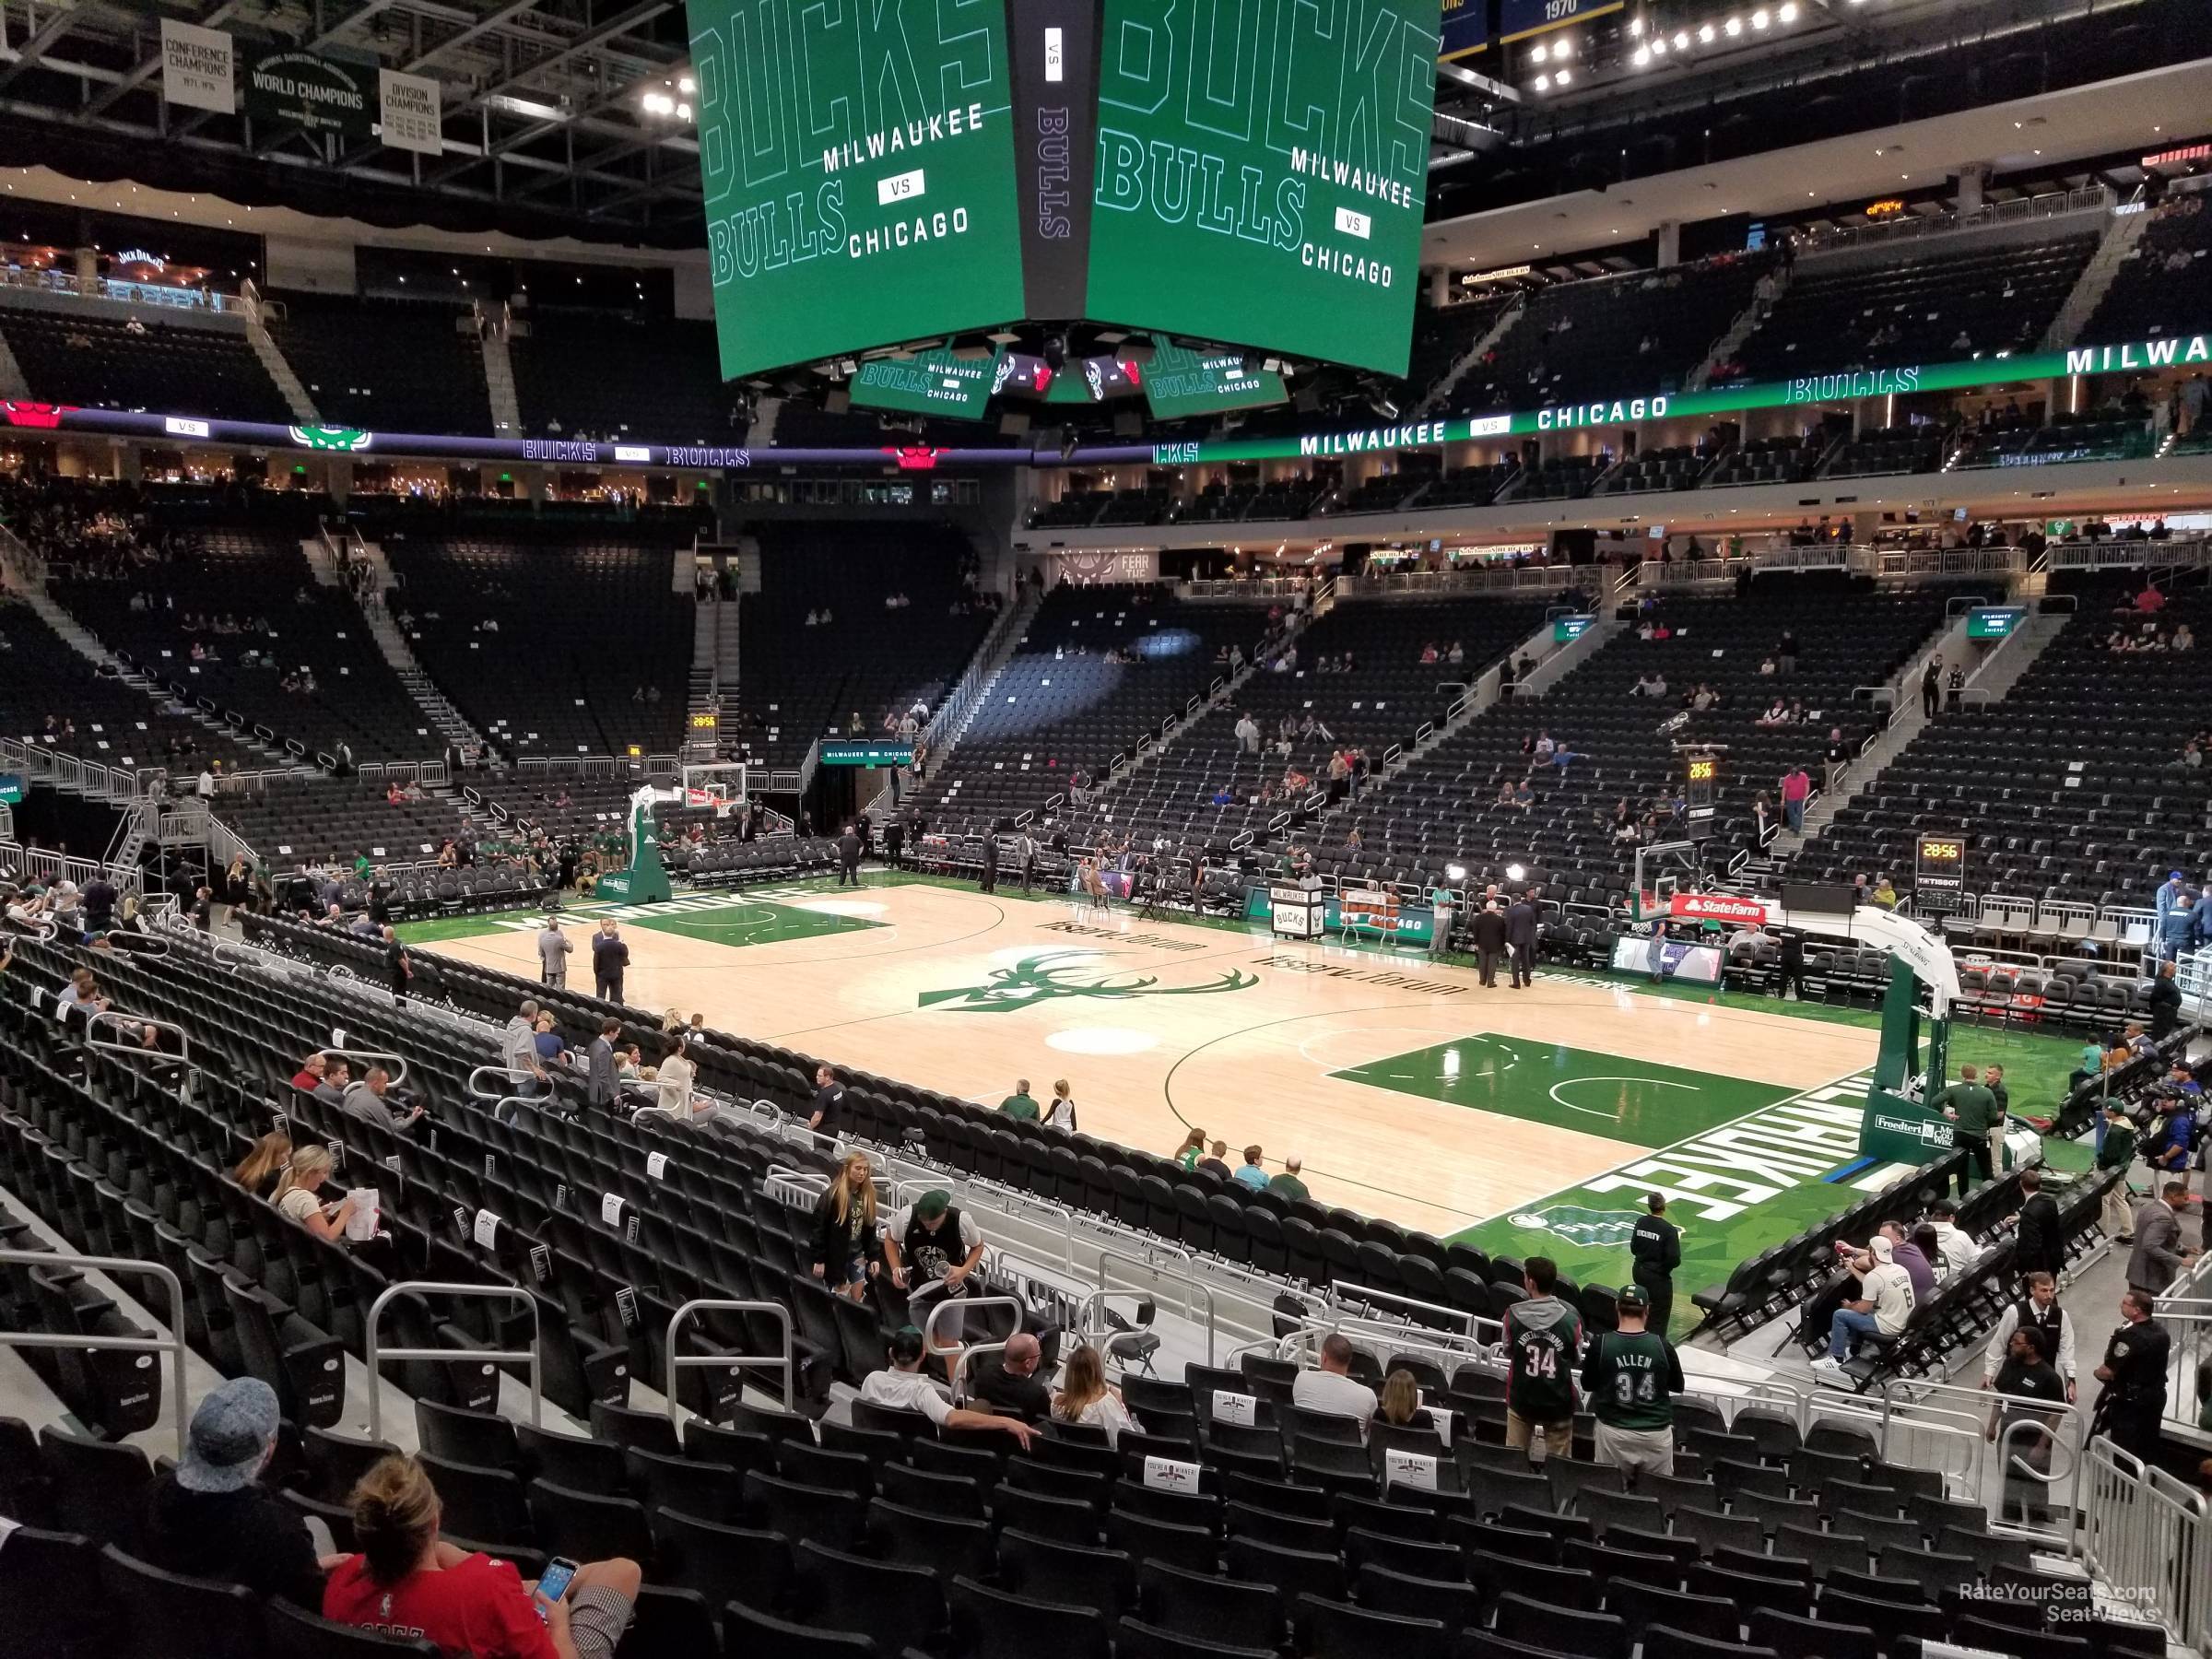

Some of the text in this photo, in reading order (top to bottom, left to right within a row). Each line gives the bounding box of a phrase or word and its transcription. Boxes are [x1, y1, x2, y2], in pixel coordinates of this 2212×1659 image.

[1545, 0, 1577, 20] 1970
[166, 39, 229, 65] CONFERENCE
[1047, 43, 1059, 65] VS
[169, 53, 228, 77] CHAMPIONS
[252, 70, 364, 111] WORLD CHAMPIONS
[392, 82, 429, 102] DIVISION
[385, 94, 436, 117] CHAMPIONS
[823, 103, 983, 173] MILWAUKEE
[1038, 108, 1071, 240] BULLS
[1291, 147, 1412, 208] MILWAUKEE
[890, 178, 911, 195] VS
[1095, 127, 1306, 252] BULLS
[708, 180, 848, 287] BULLS
[849, 207, 969, 259] CHICAGO
[1345, 214, 1361, 232] VS
[1301, 242, 1393, 288] CHICAGO
[2065, 335, 2209, 374] MILWA
[860, 363, 934, 394] BULLS
[927, 363, 982, 380] MILWAUKEE
[927, 389, 968, 403] CHICAGO
[1150, 371, 1218, 399] BULLS
[1218, 380, 1260, 394] CHICAGO
[178, 421, 196, 433] VS
[1300, 396, 1667, 456] MILWAUKEE VS CHICAGO
[522, 439, 597, 462] BUCKS
[1122, 554, 1149, 569] FEAR
[1690, 761, 1712, 780] 28:56
[1923, 843, 1958, 858] 28:56
[1930, 877, 1960, 887] TISSOT
[1273, 888, 1306, 902] MILWAUKEE
[1277, 911, 1305, 928] BUCKS
[1117, 933, 1209, 952] forum
[1902, 941, 1931, 967] SPALDING
[1356, 971, 1470, 995] forum
[1878, 1117, 1922, 1134] Froedtert
[1552, 1220, 1636, 1233] UCKS
[925, 1245, 937, 1255] 34
[1902, 1287, 1913, 1309] 6
[1525, 1345, 1557, 1379] 34
[1616, 1354, 1653, 1370] ALLEN
[1616, 1371, 1656, 1404] 34
[1175, 1465, 1196, 1476] WINNER!
